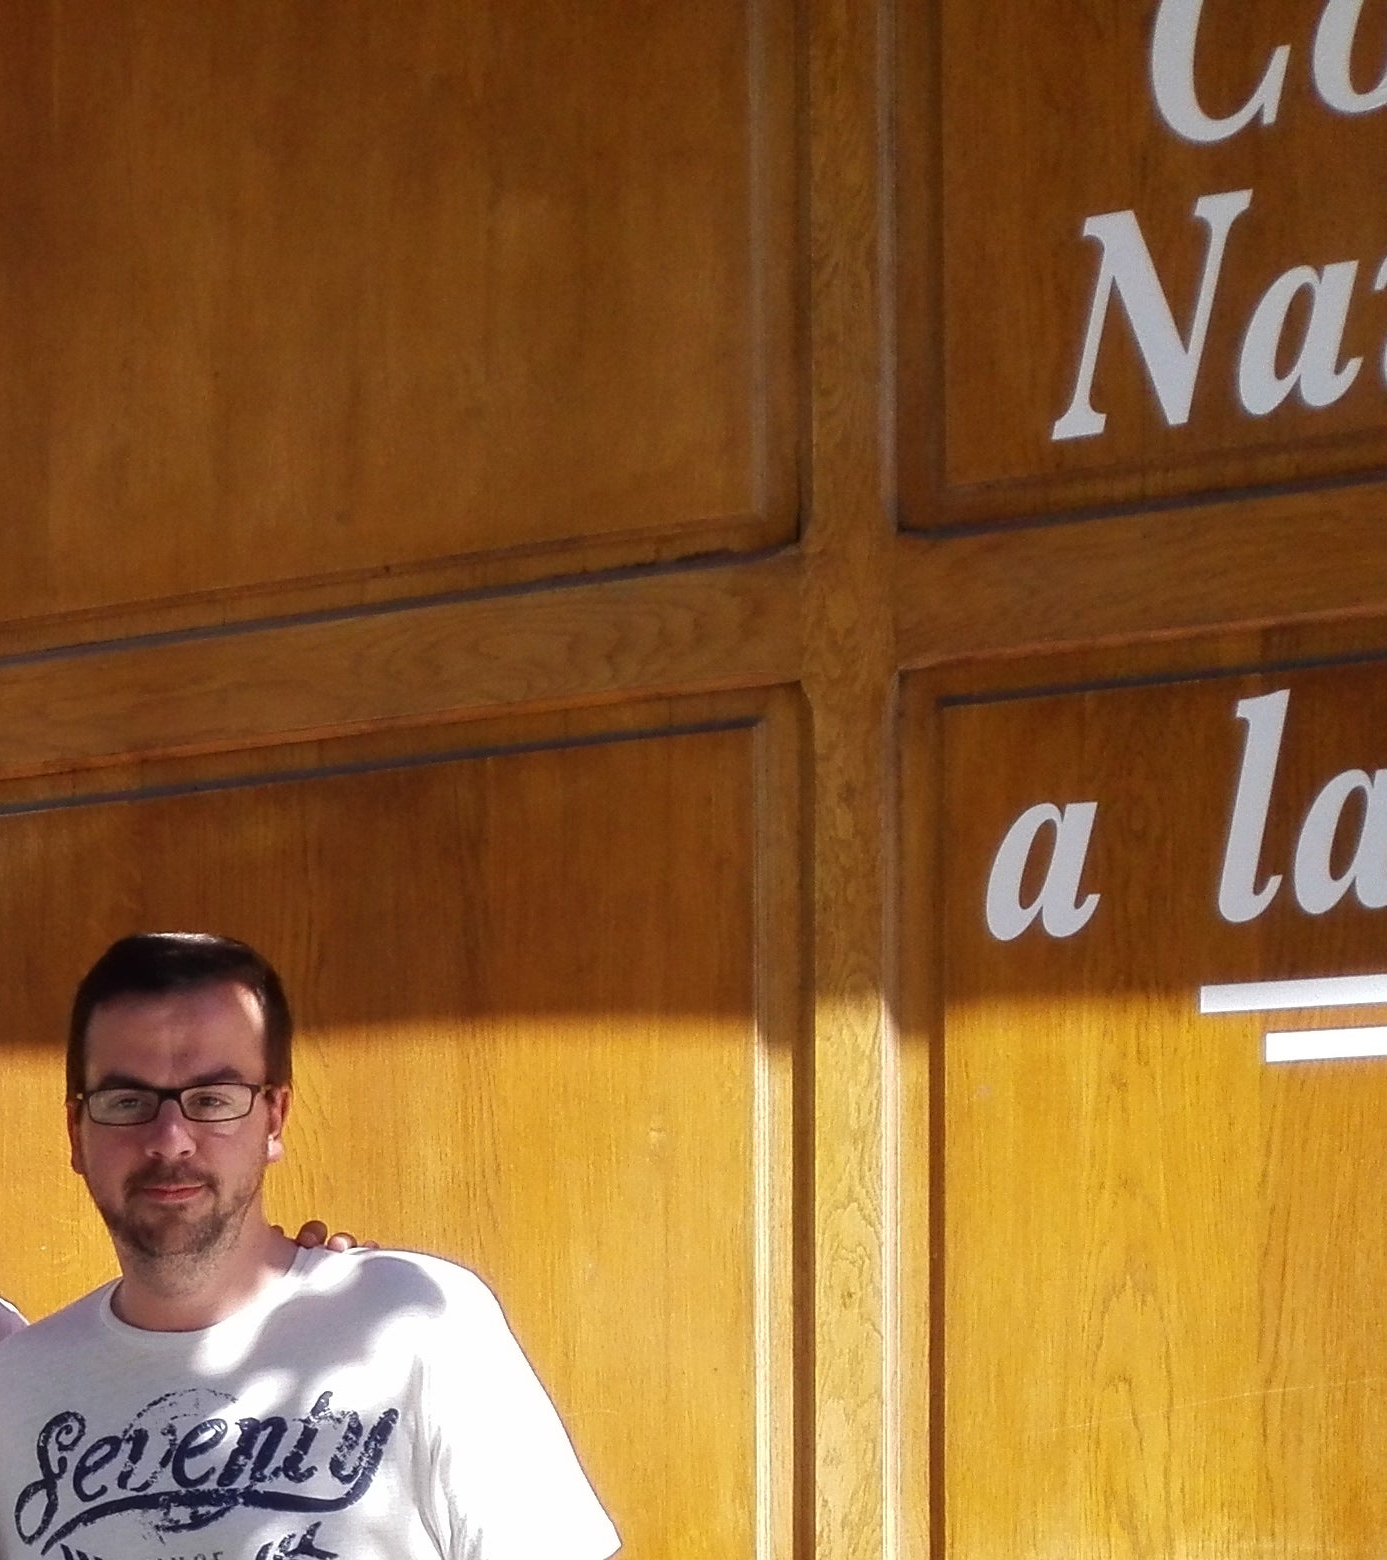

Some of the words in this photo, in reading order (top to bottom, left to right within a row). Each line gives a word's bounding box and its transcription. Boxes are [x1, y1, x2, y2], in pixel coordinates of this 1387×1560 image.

[1051, 189, 1387, 440] Na
[986, 801, 1101, 941] a
[1218, 688, 1387, 923] la
